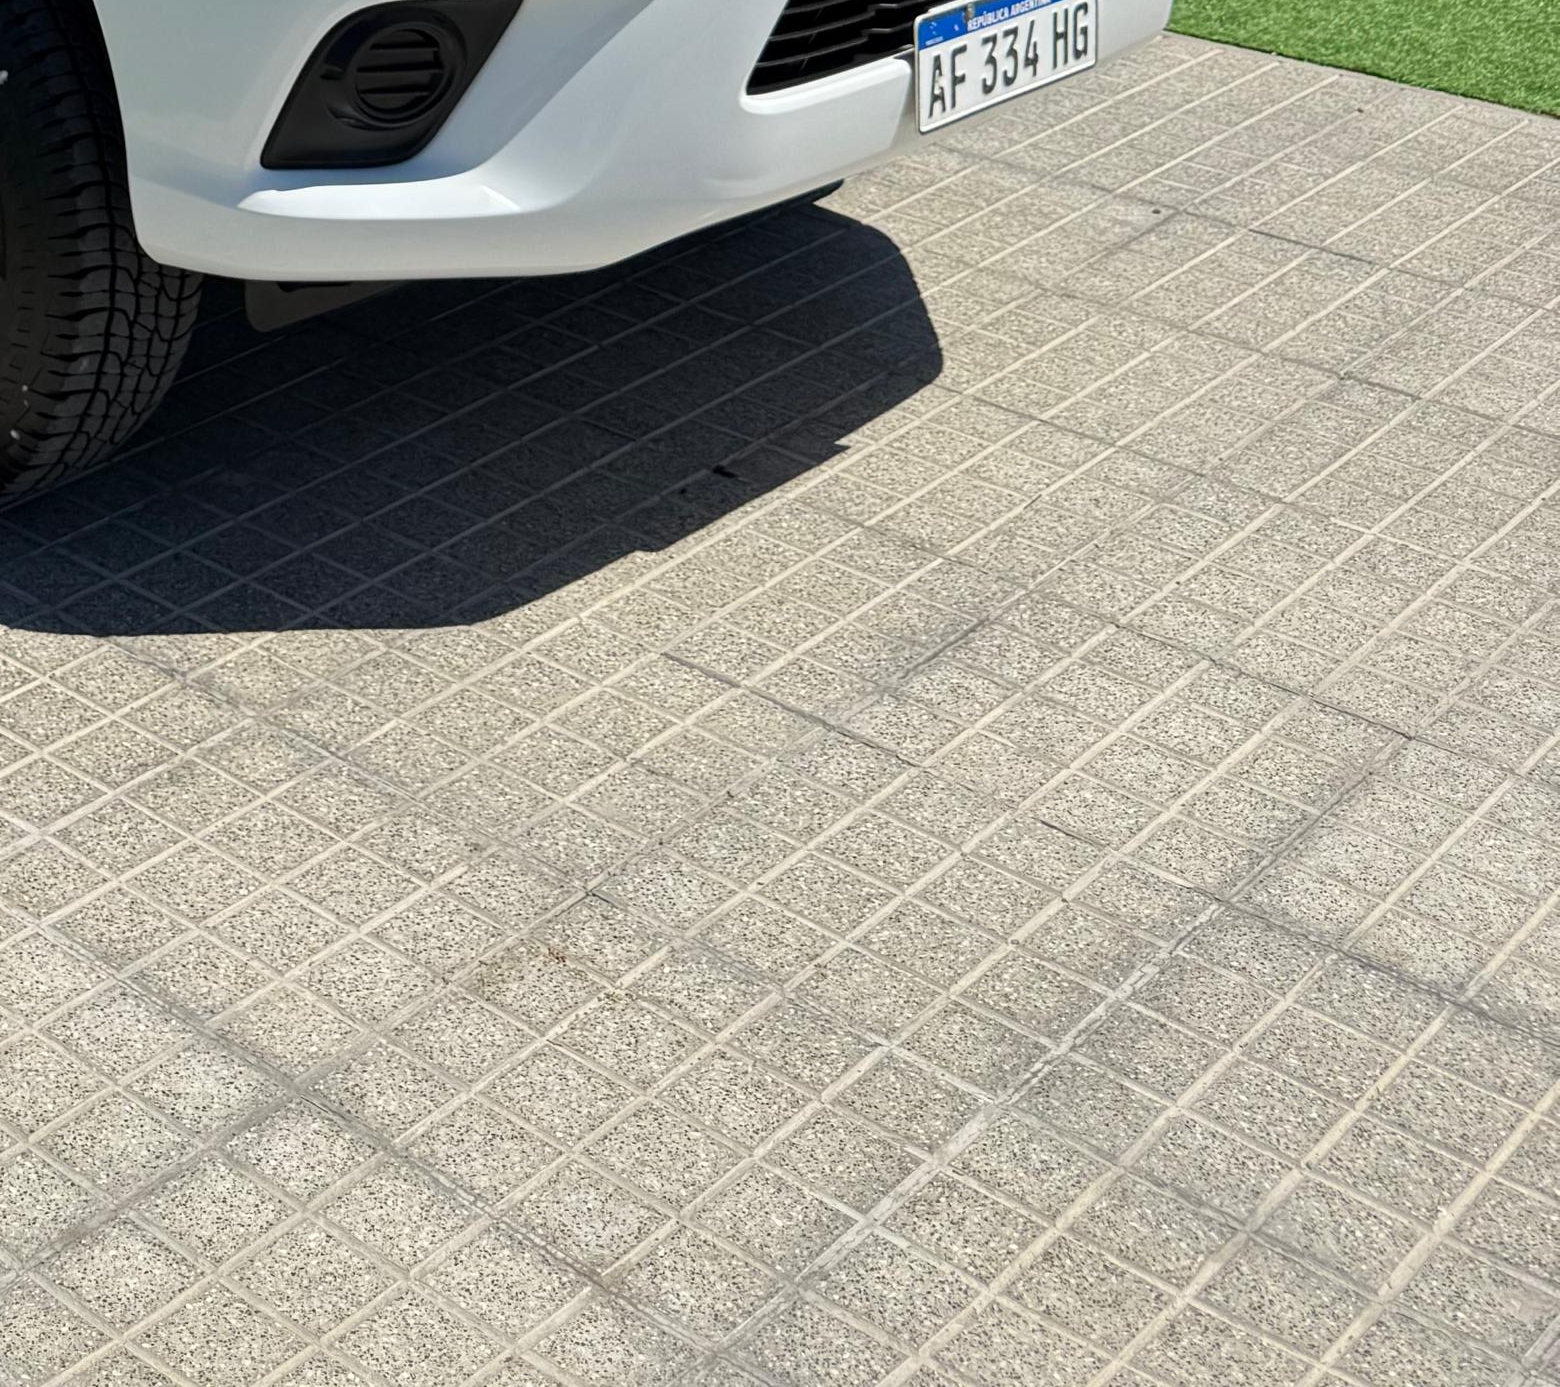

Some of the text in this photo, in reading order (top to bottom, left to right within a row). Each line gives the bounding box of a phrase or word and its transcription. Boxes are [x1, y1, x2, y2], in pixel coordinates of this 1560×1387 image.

[966, 11, 1010, 31] REPÚBLICA
[928, 1, 1089, 119] AF 334 HG
